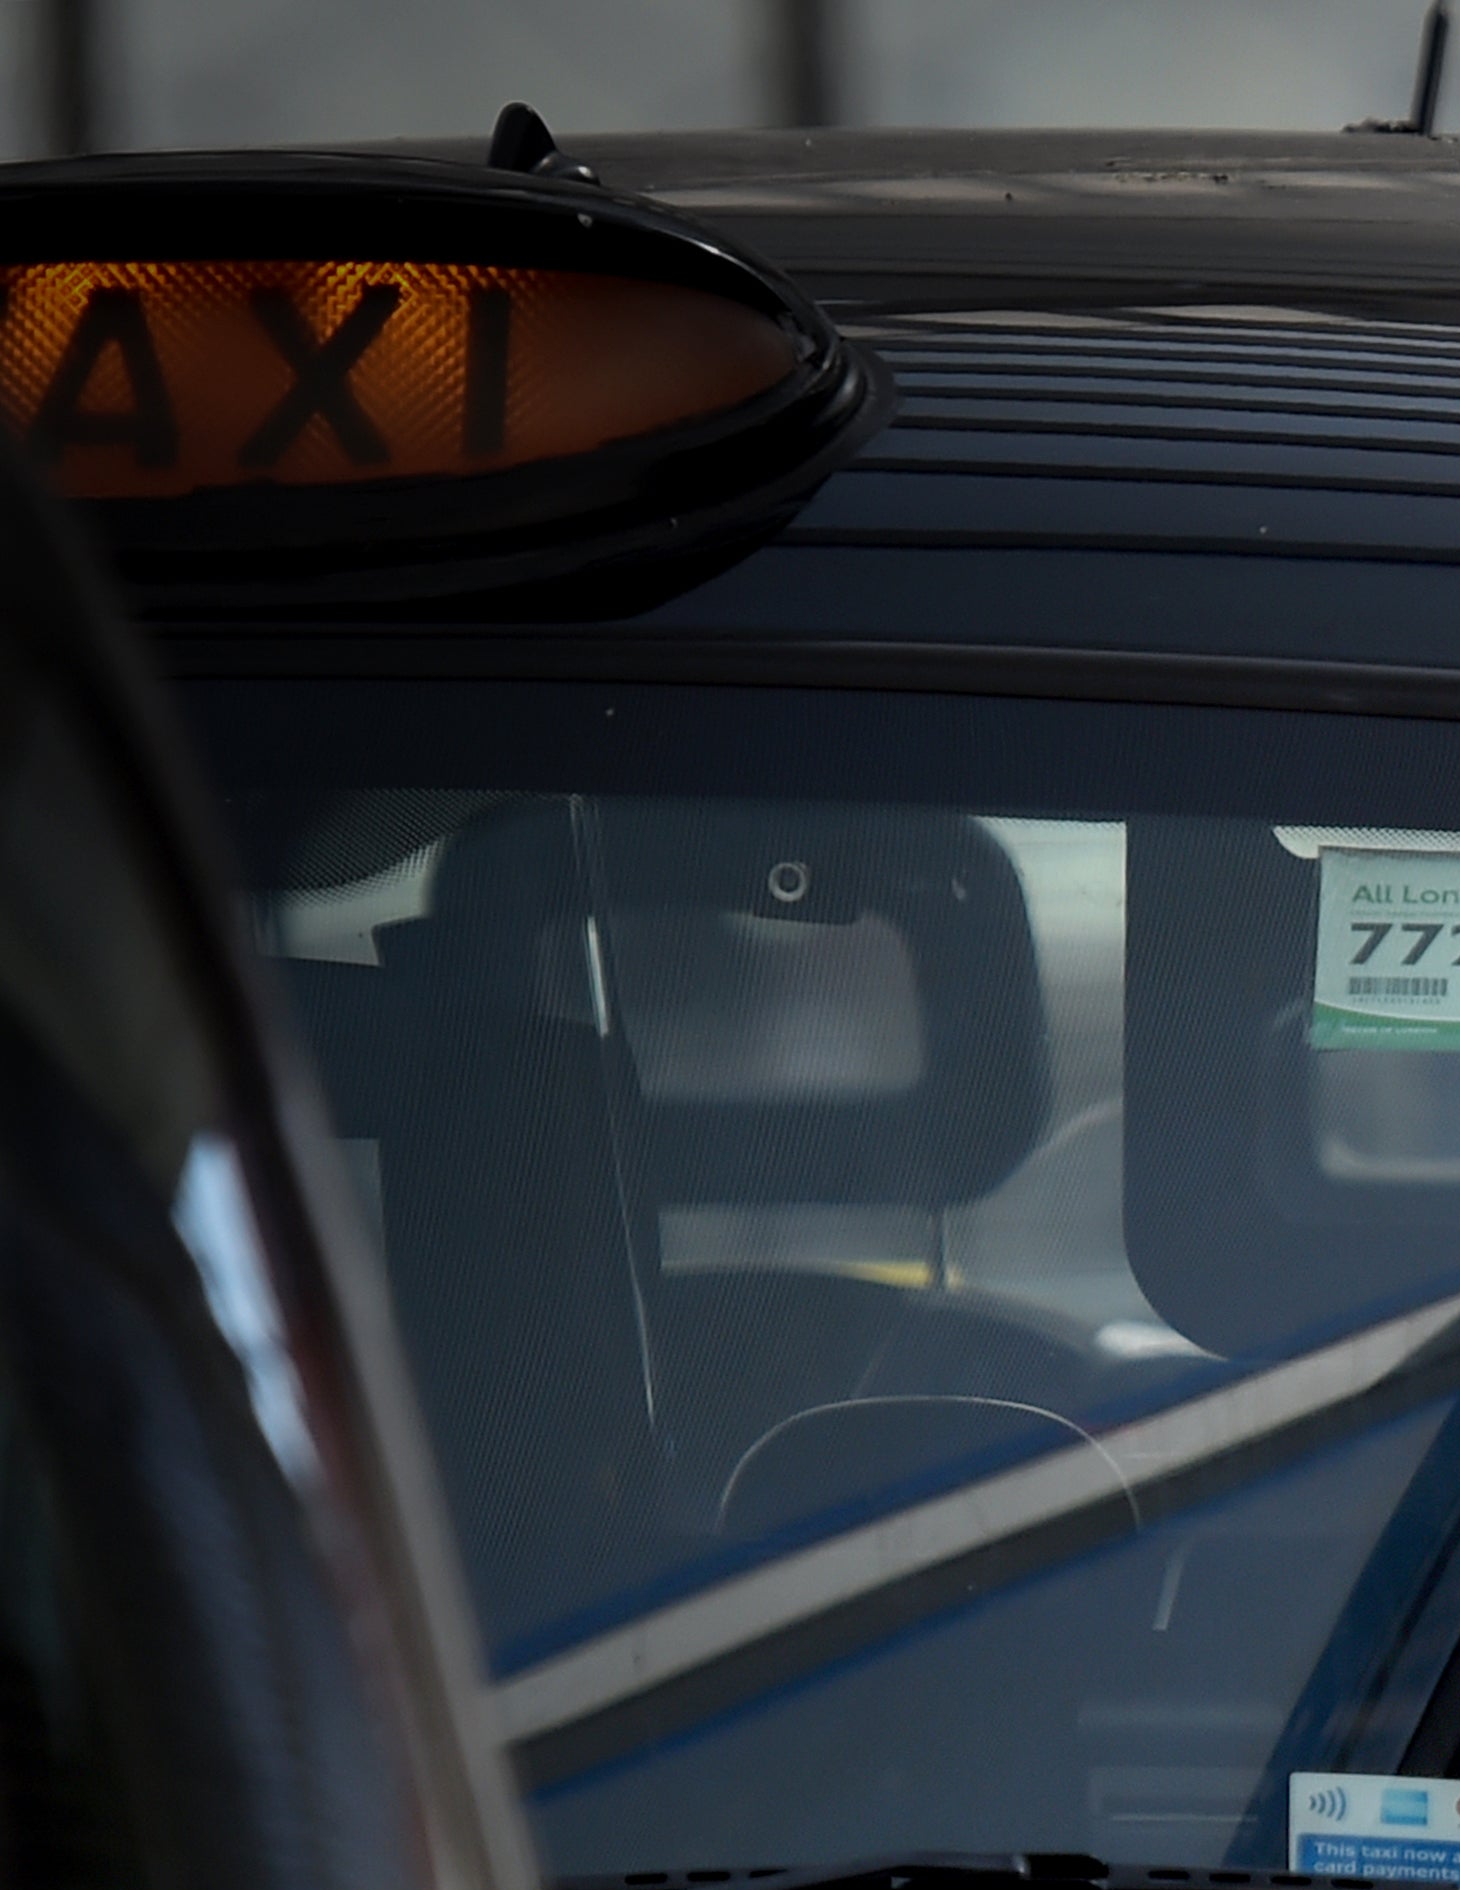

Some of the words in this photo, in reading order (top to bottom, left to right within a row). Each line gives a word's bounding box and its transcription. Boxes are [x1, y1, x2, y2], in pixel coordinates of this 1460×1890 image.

[0, 284, 512, 466] AXI
[1352, 884, 1392, 905] All
[1314, 1841, 1356, 1858] This
[1362, 1843, 1399, 1859] taxi
[1404, 1848, 1447, 1863] now
[1314, 1860, 1357, 1874] card
[1363, 1864, 1460, 1882] payments
